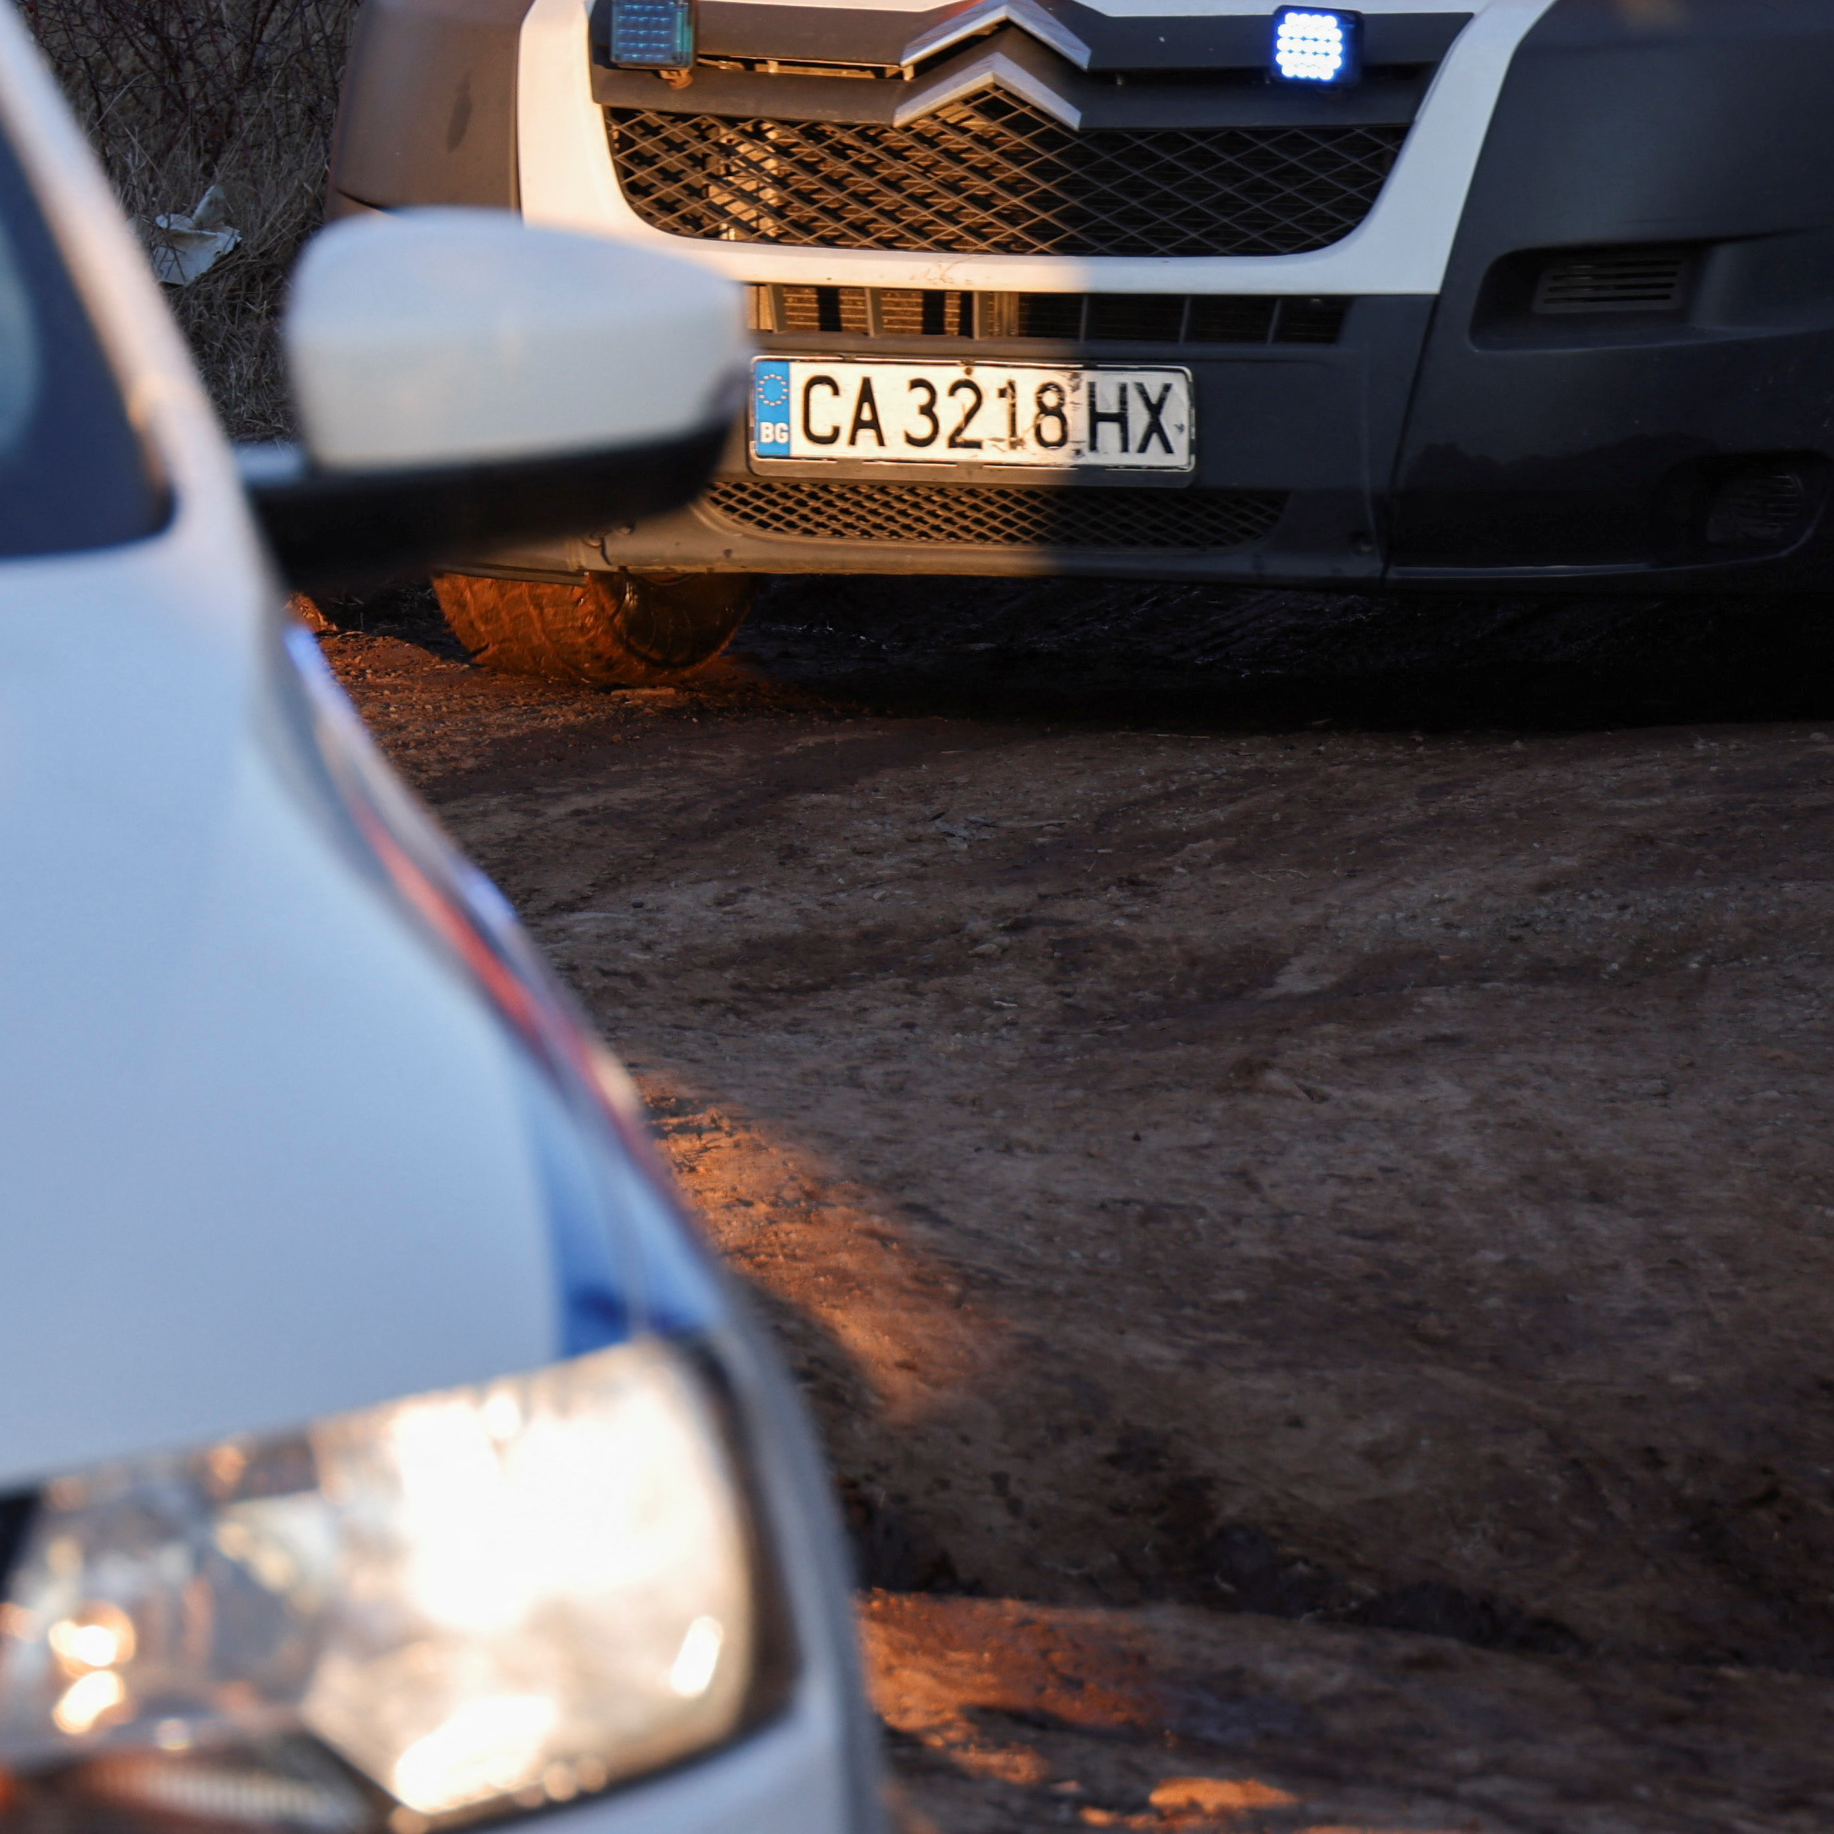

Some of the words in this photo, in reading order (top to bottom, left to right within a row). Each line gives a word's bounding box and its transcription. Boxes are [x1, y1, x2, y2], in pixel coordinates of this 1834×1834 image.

[760, 421, 788, 444] BG
[801, 375, 887, 448] CA
[904, 378, 1070, 451] 3218
[1088, 381, 1174, 455] HX
